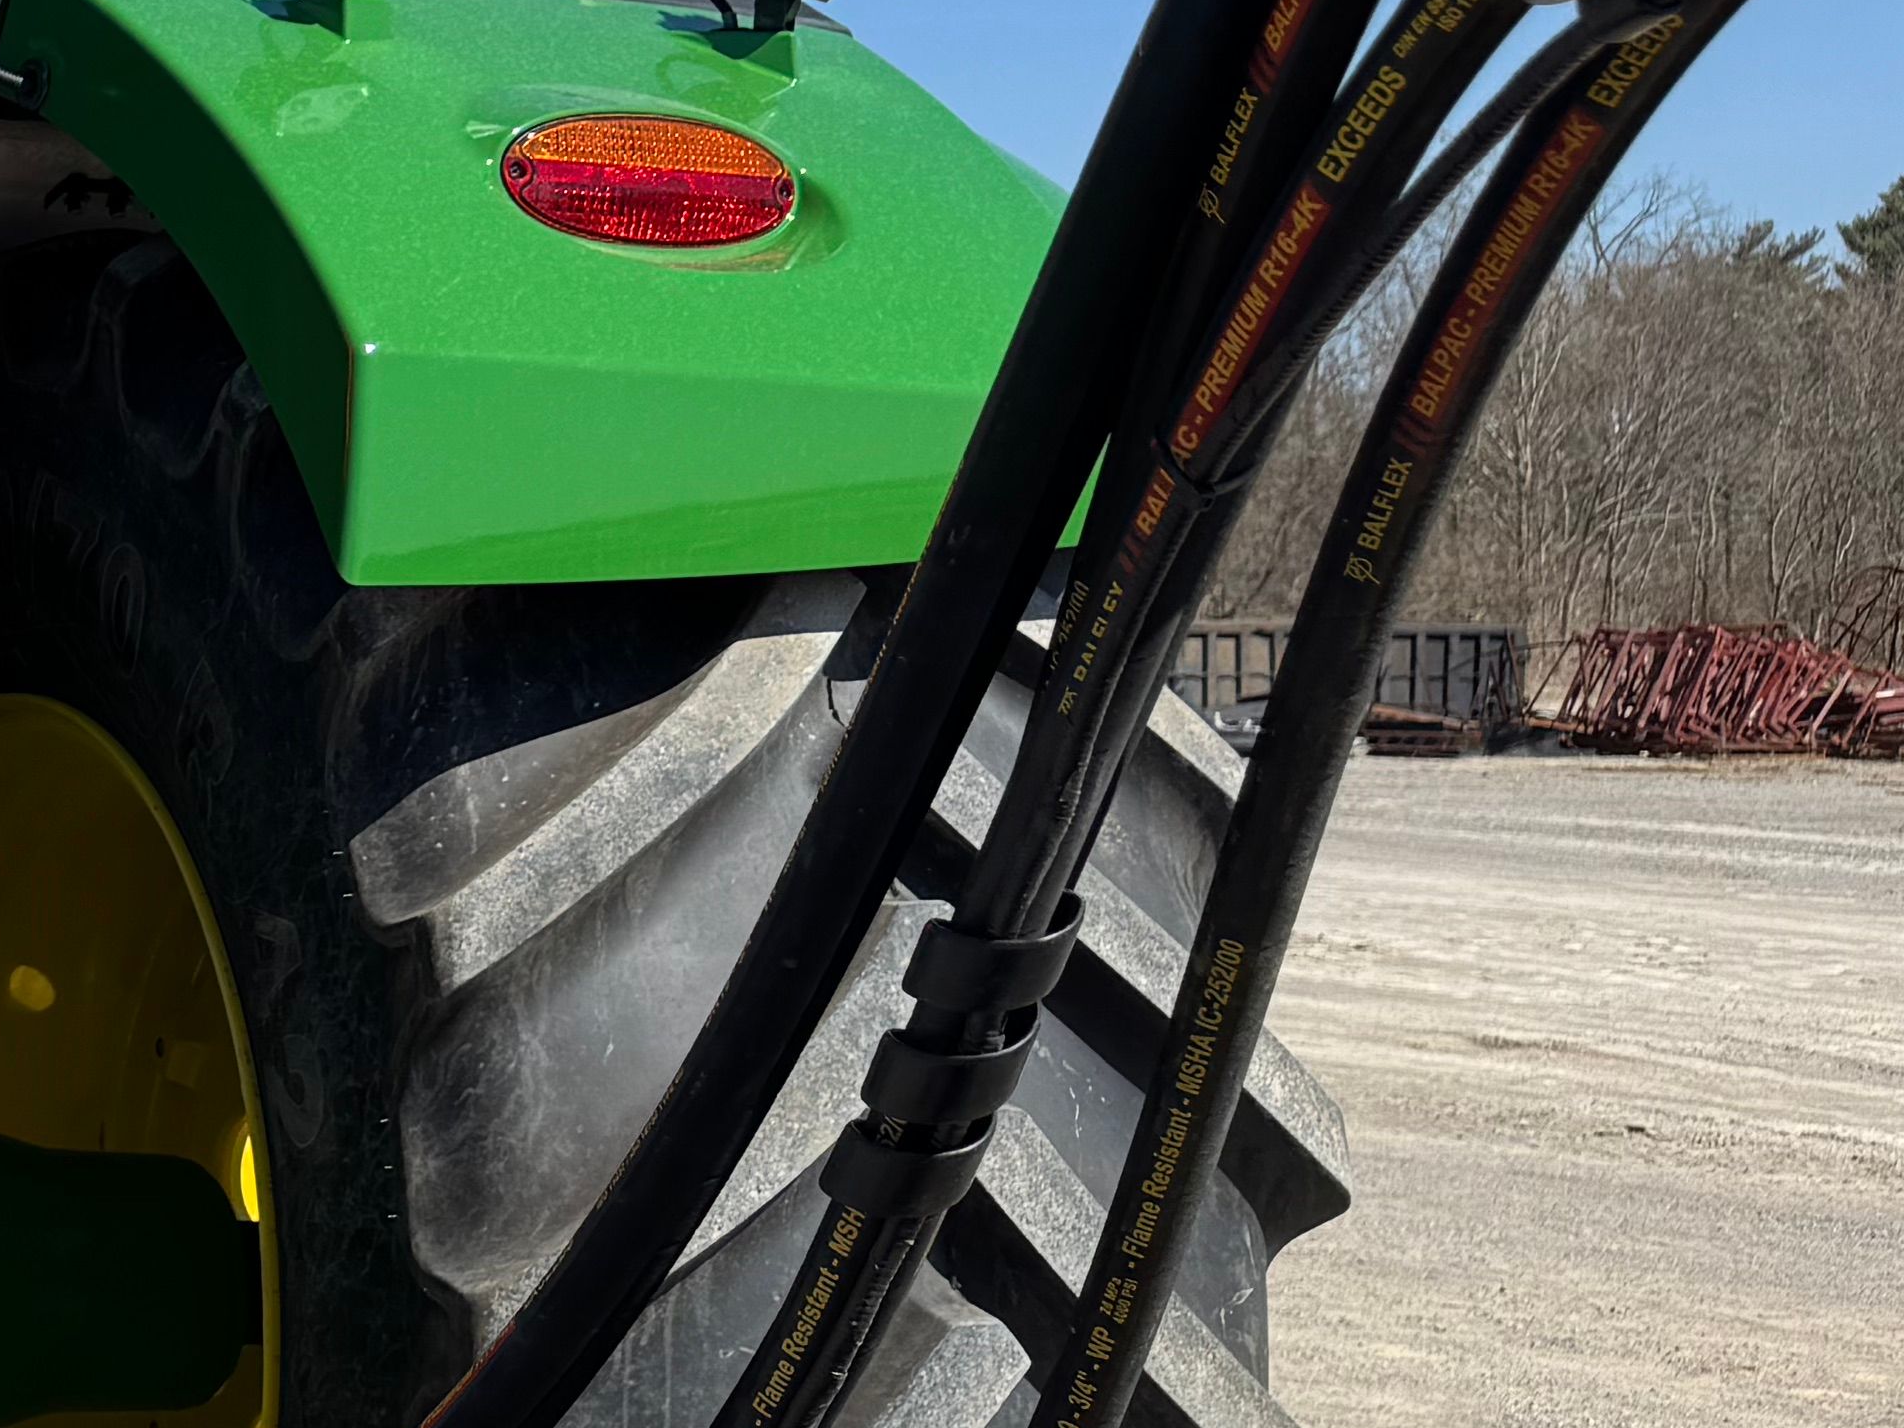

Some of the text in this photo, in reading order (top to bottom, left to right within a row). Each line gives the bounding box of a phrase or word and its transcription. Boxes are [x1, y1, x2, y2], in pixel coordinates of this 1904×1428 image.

[1587, 12, 1684, 108] EXCEEDS
[1209, 87, 1259, 186] BALFLEX
[1316, 64, 1408, 183] EXCEEDS
[1411, 108, 1594, 419] BALPAC PREMIUM R16-4K
[1136, 194, 1323, 537] BALAC PREMIUM R16-4K
[1357, 456, 1413, 552] BALFLEX
[1194, 938, 1246, 1039] IC-252/00
[1175, 1022, 1218, 1097] MSHA
[1142, 1101, 1193, 1202] Resistant
[1121, 1202, 1162, 1260] Flame
[752, 1205, 867, 1419] Flame Resistant MSH
[1085, 1325, 1116, 1361] WP
[1067, 1369, 1099, 1412] 3/4"
